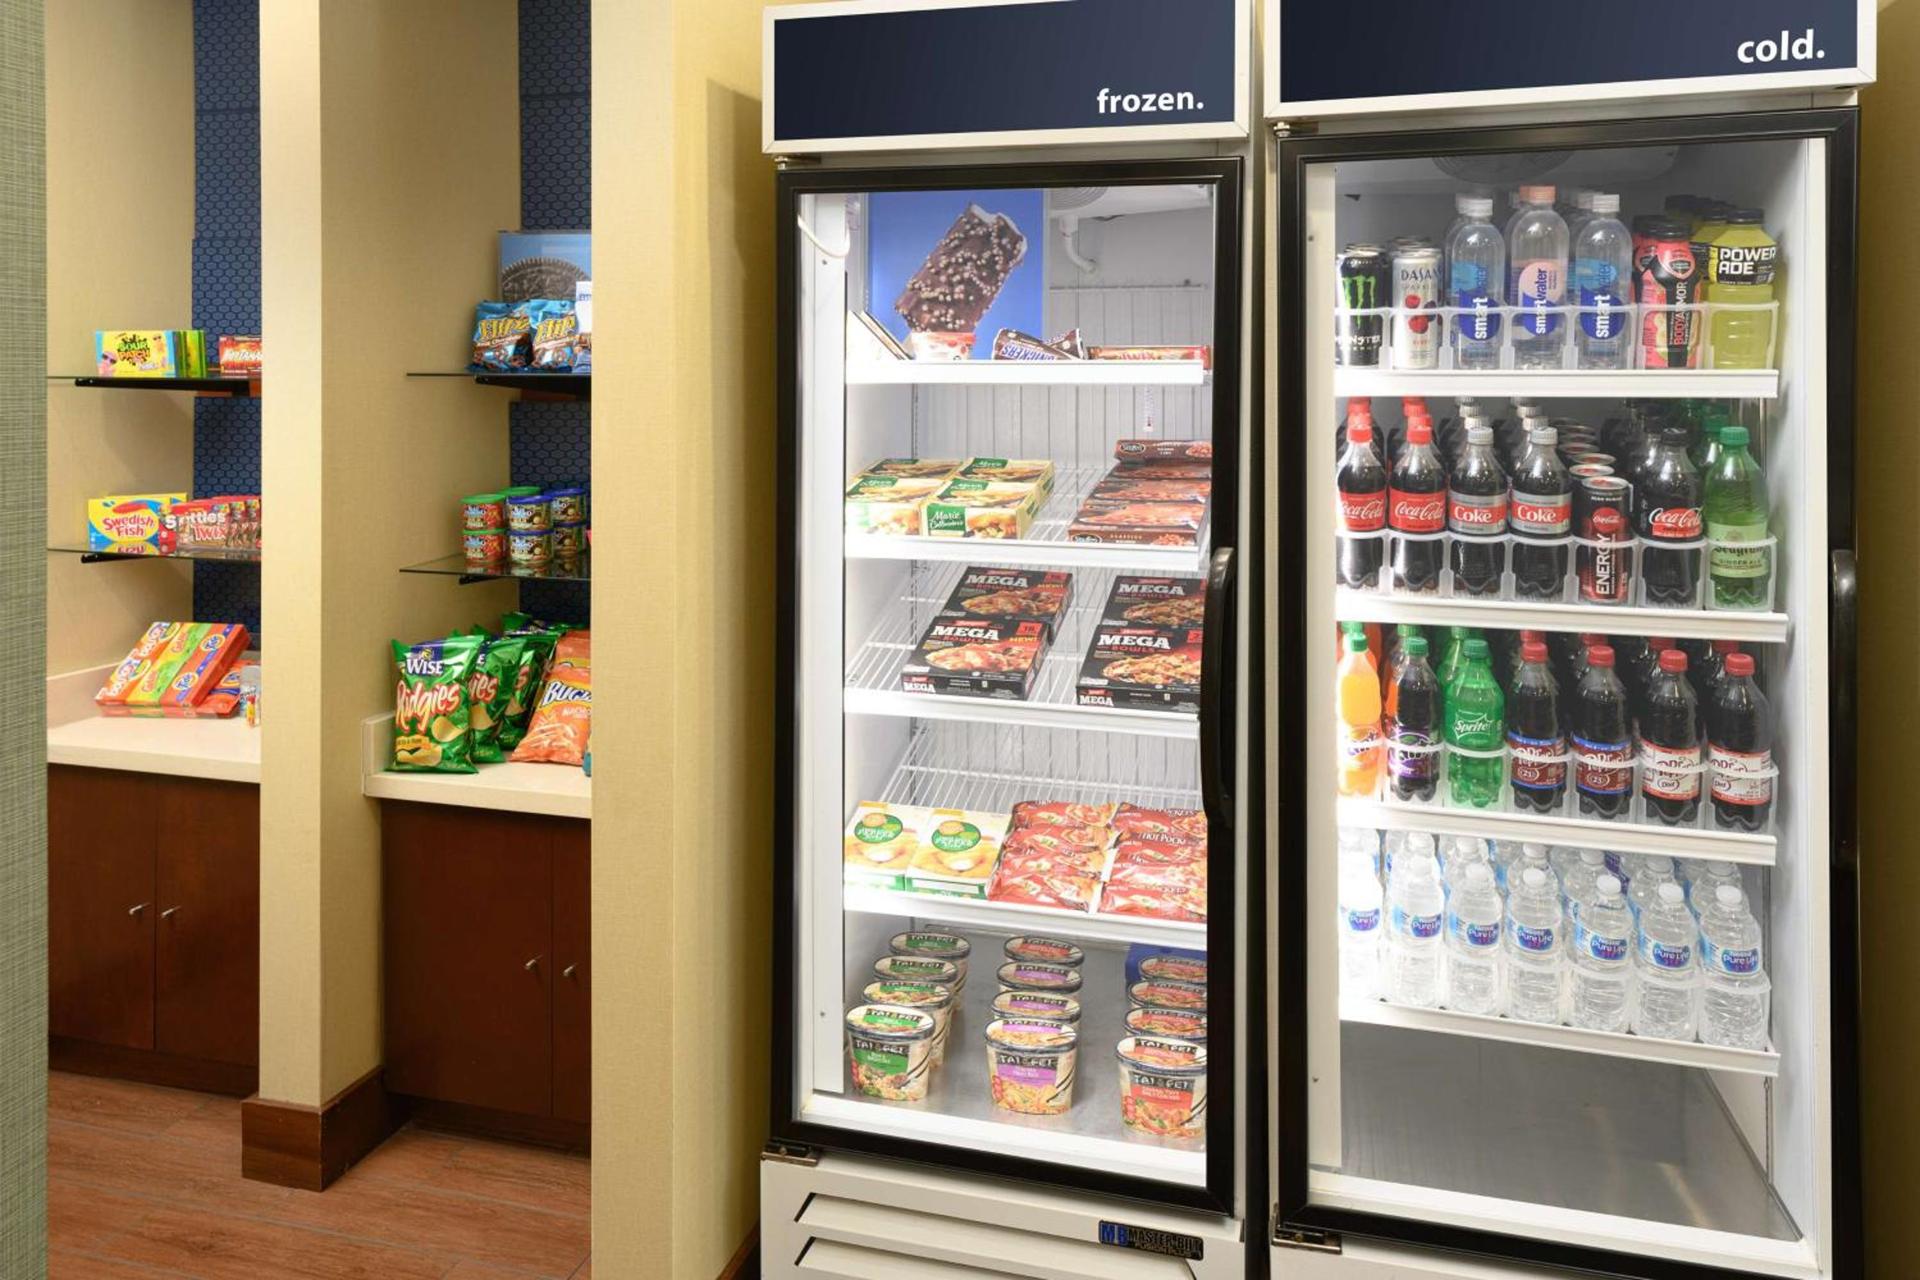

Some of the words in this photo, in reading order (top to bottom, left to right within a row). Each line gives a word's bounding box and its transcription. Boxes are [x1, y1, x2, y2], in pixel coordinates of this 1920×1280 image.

[1736, 30, 1826, 64] cold.
[1097, 88, 1204, 114] frozen.
[1720, 247, 1776, 261] POWER
[1719, 262, 1755, 274] ADE
[1674, 281, 1689, 345] BODYAMOR
[931, 510, 960, 520] Marie
[1395, 501, 1443, 521] Coca-Cola
[1454, 506, 1492, 523] Coke
[1518, 505, 1557, 523] Coke
[1649, 506, 1704, 528] Coca-Cola
[103, 515, 155, 531] Swedish
[117, 525, 145, 537] Fish
[1595, 533, 1611, 595] ENERGY
[965, 574, 1029, 588] MEGA
[1118, 584, 1185, 596] MEGA
[930, 625, 999, 641] MEGA
[1097, 634, 1171, 650] MEGA
[406, 658, 444, 675] WISE
[903, 682, 936, 694] MEGA
[396, 680, 461, 734] Ridgies
[1079, 695, 1114, 707] MEGA
[1455, 721, 1489, 736] Sprite
[1000, 1054, 1021, 1064] TAI
[1030, 1057, 1052, 1067] PEI
[1134, 1074, 1157, 1085] TAI
[1166, 1078, 1191, 1089] PEI
